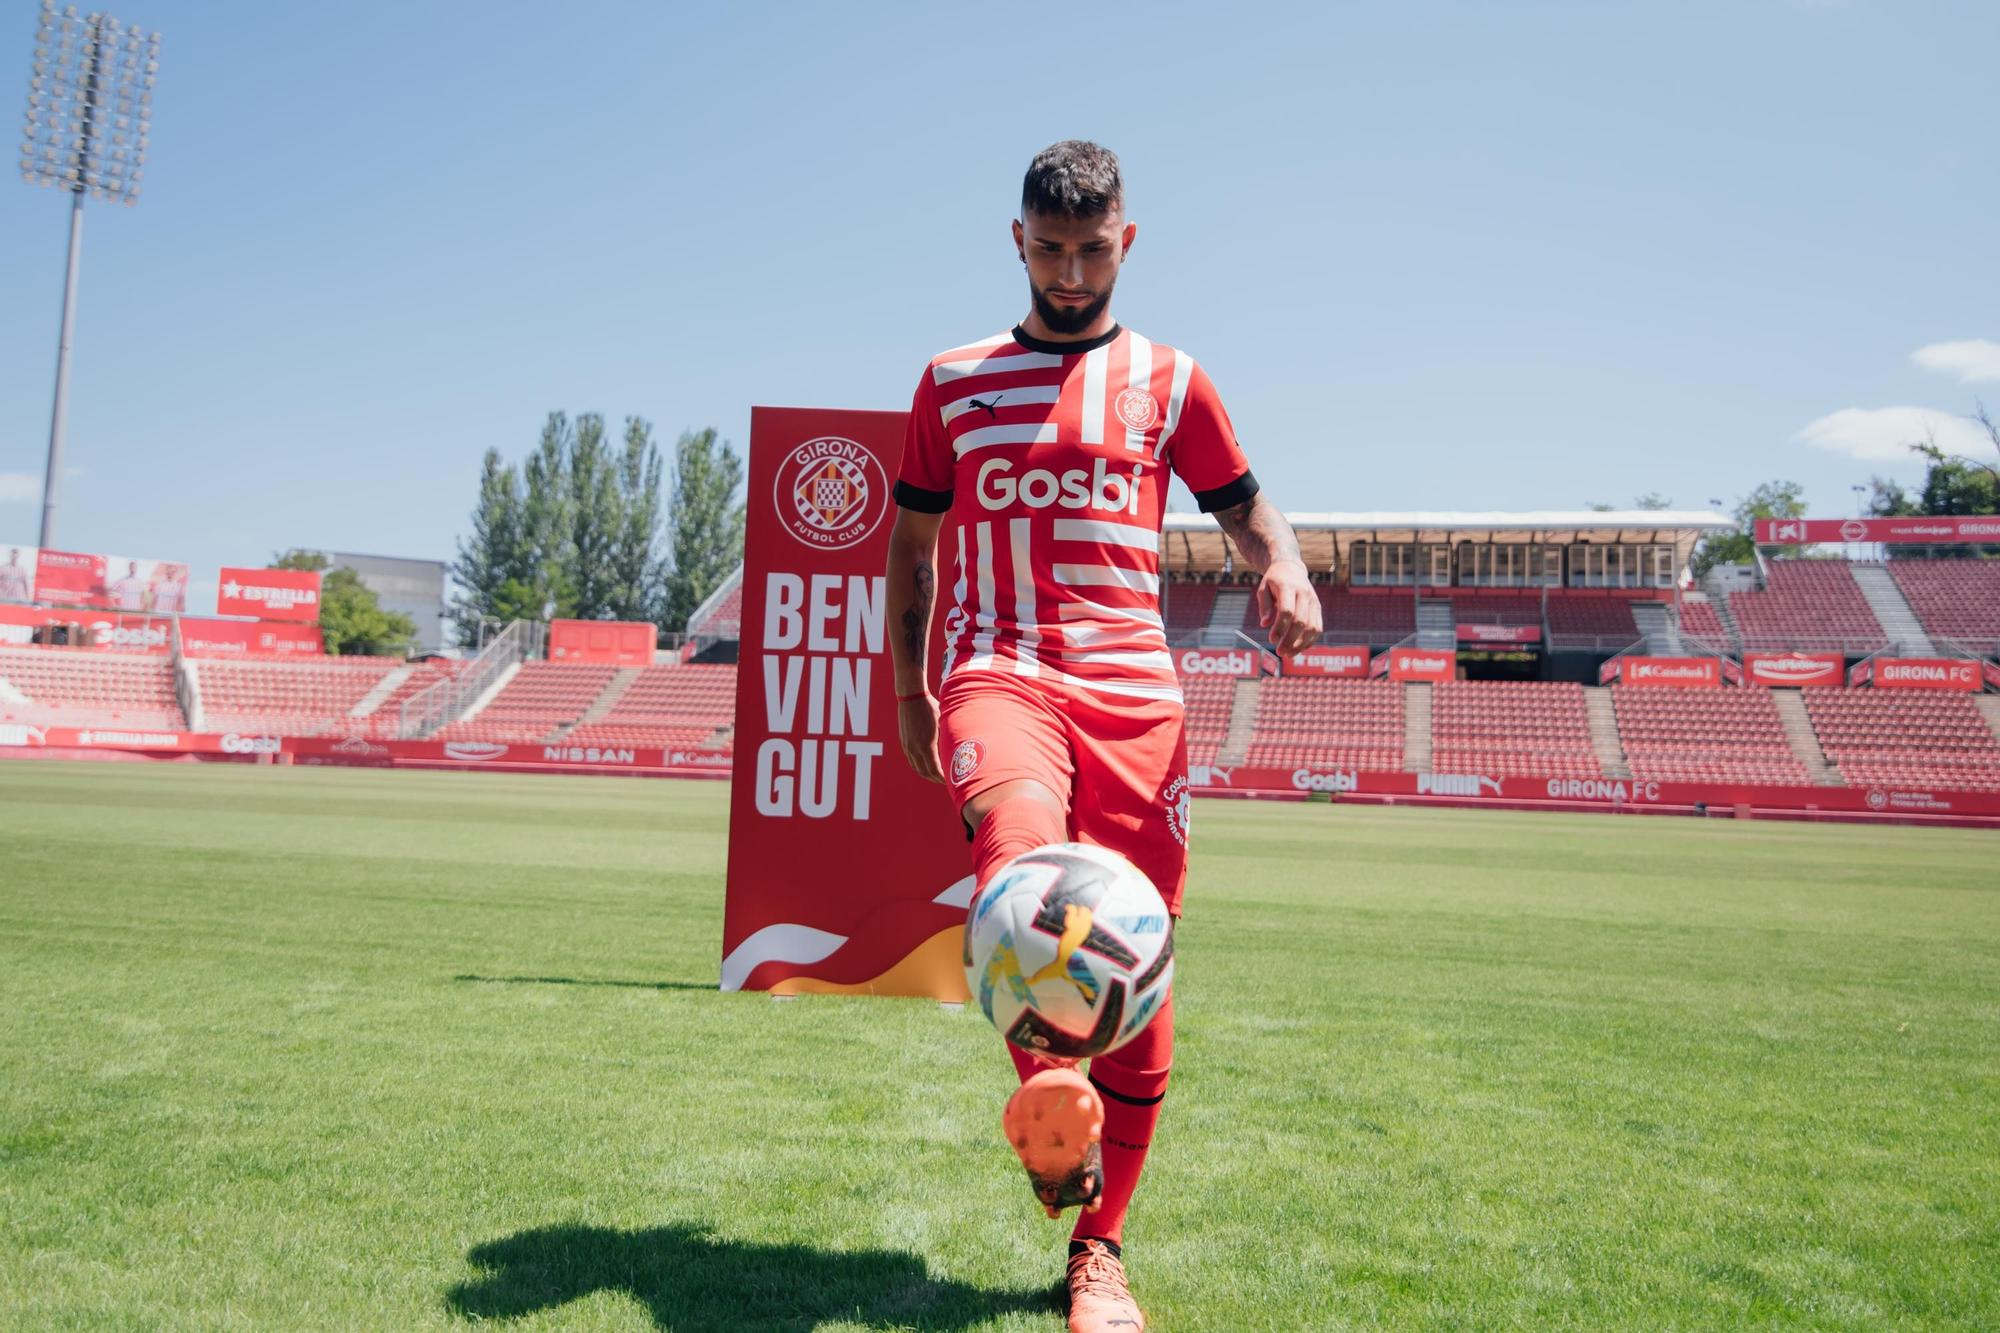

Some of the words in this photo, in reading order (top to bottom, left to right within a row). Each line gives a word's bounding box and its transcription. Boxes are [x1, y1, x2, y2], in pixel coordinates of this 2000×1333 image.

[796, 441, 869, 470] GIRONA
[976, 457, 1143, 516] Gosbi
[794, 520, 835, 542] FUTBOL
[838, 522, 866, 541] CLUB
[243, 586, 316, 604] ESTRELLA
[763, 572, 887, 654] BEN
[1181, 651, 1252, 674] Gosbi
[1307, 655, 1361, 667] ESTRELLA
[1883, 665, 1945, 681] GIRONA
[1949, 667, 1972, 682] FC
[762, 654, 872, 736] VIN
[220, 733, 281, 753] Gosbi
[543, 747, 635, 763] NISSAN
[755, 737, 884, 821] GUT
[1292, 768, 1357, 791] Gosbi
[1417, 773, 1480, 797] PUMA
[1547, 779, 1627, 799] GIRONA
[1632, 782, 1661, 801] FC
